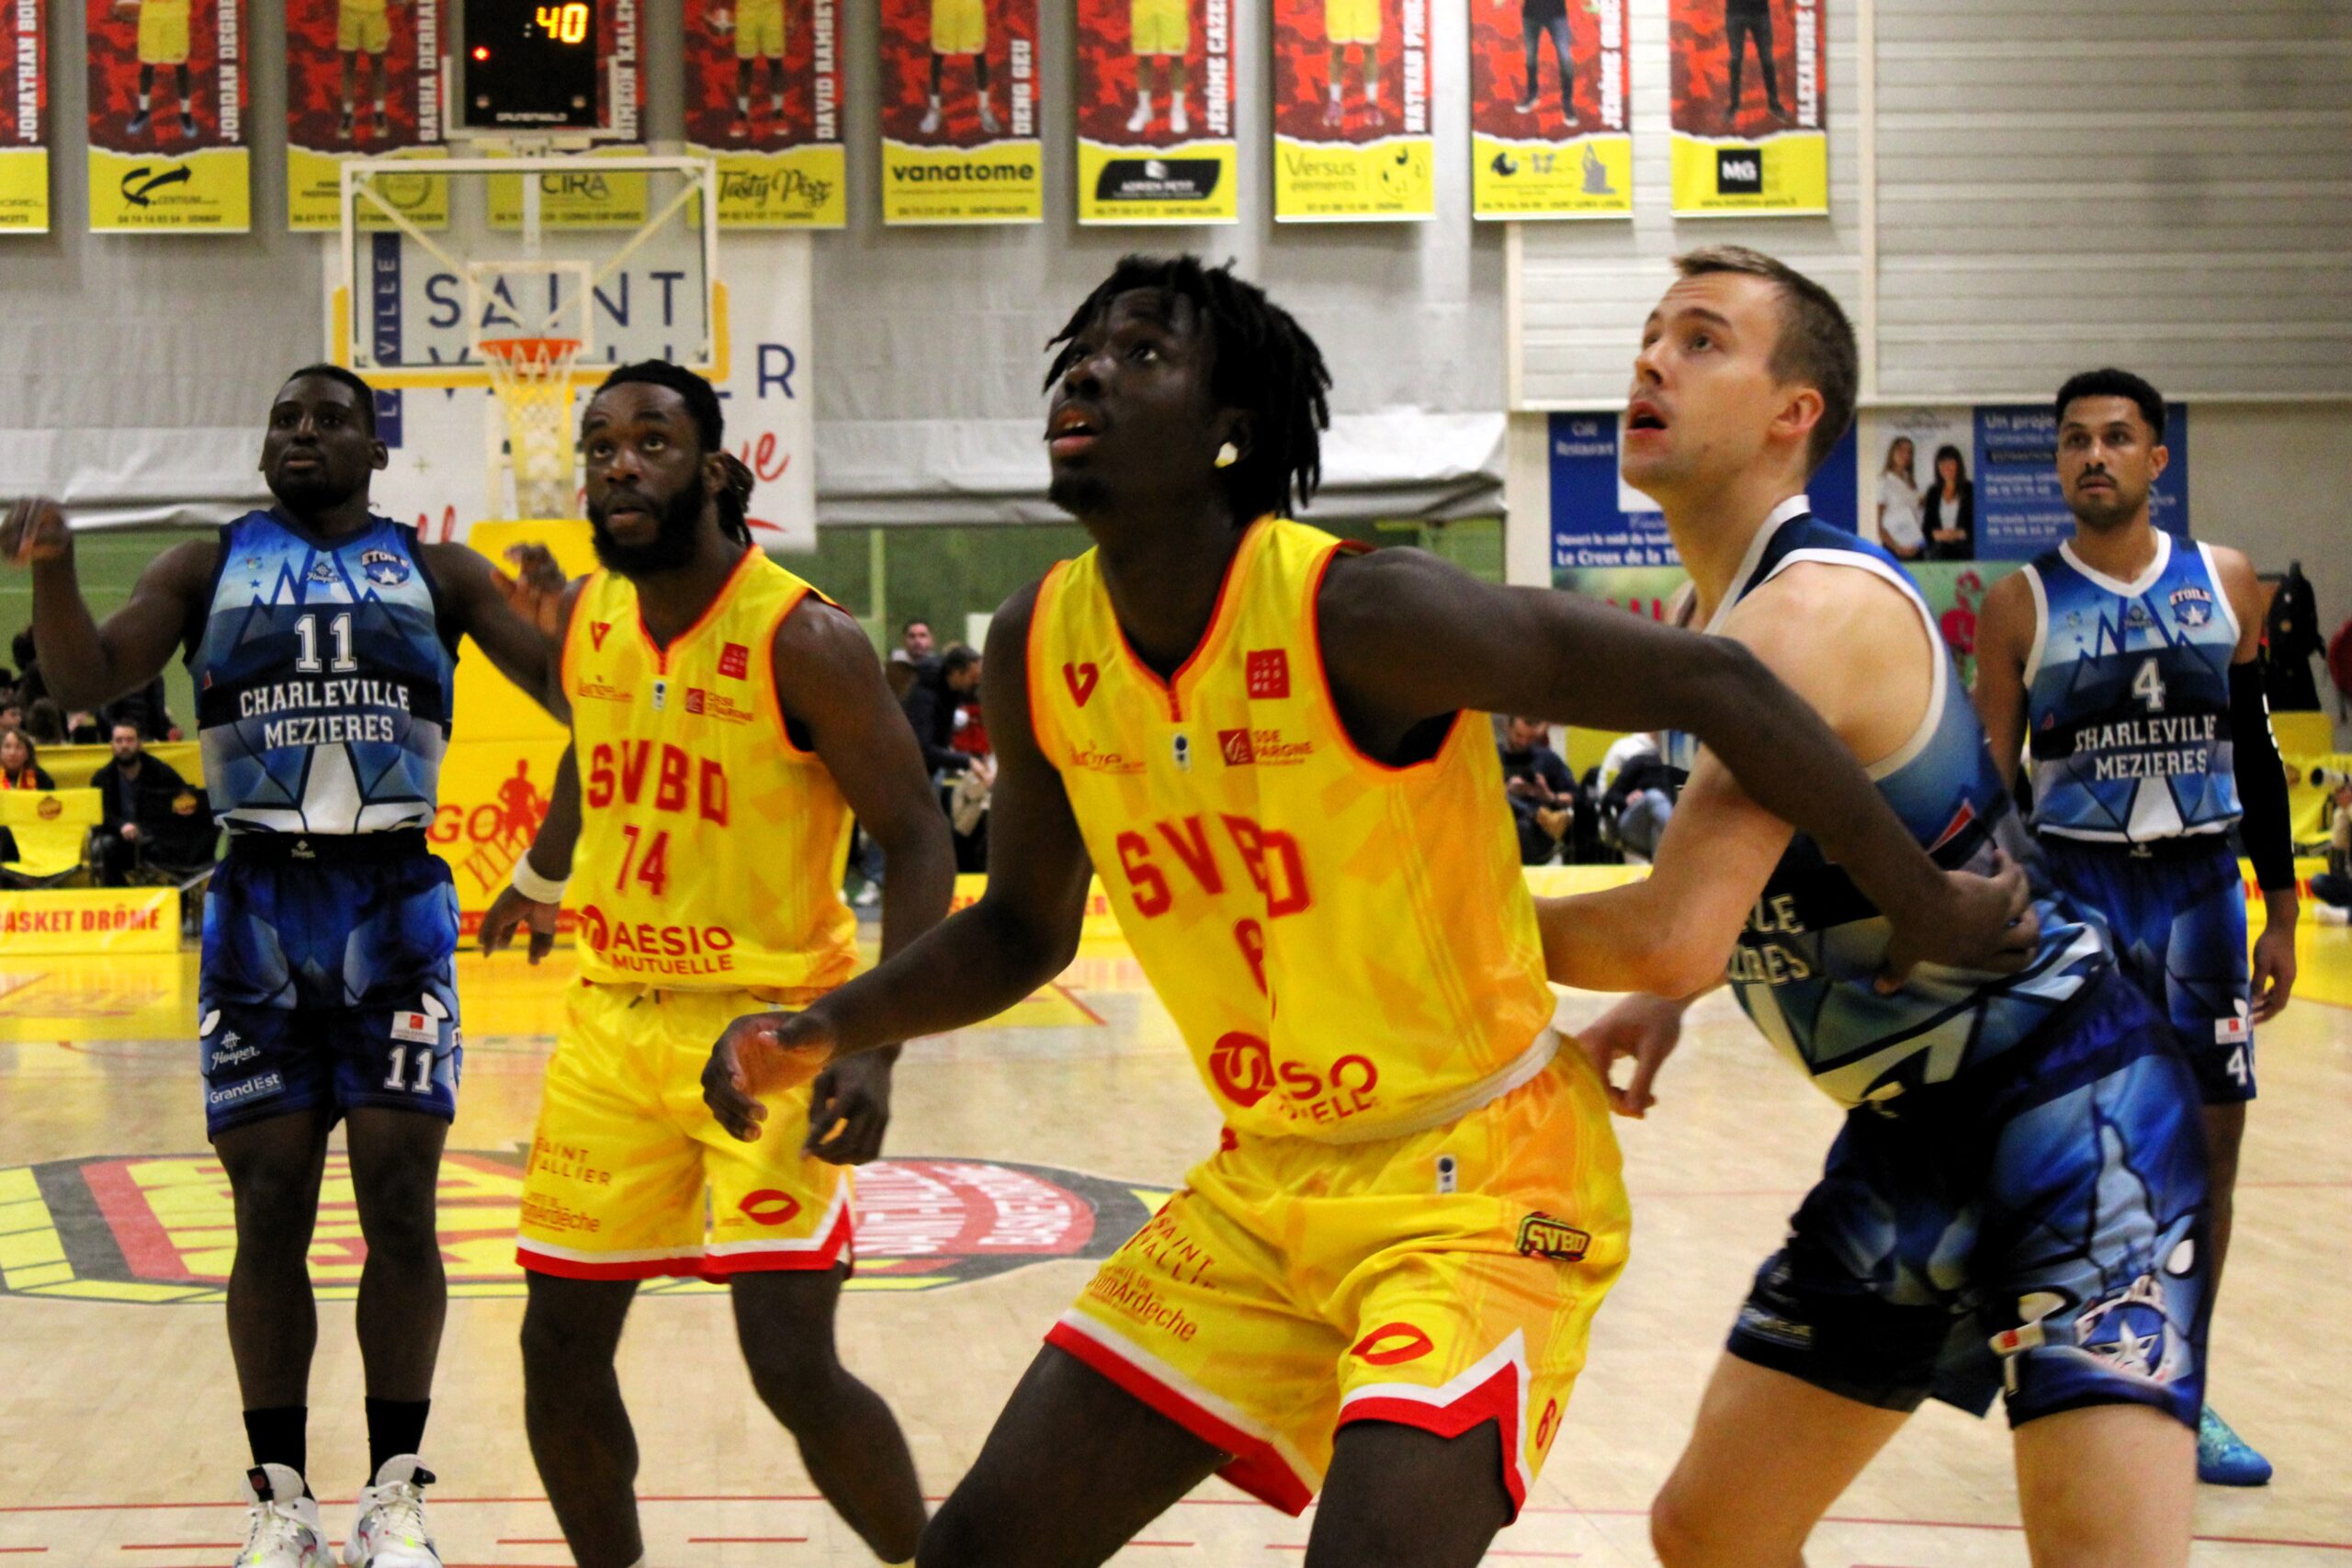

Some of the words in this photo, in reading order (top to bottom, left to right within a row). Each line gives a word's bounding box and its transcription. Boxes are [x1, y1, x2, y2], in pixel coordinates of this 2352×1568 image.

[537, 3, 589, 43] 40
[17, 37, 38, 142] JONATHAN
[220, 63, 239, 141] JORDAN
[815, 77, 835, 140] DAVID
[893, 163, 1035, 182] vanatome
[1284, 152, 1357, 175] Versus
[1722, 160, 1758, 181] MG
[425, 272, 684, 329] SAINT
[295, 613, 358, 673] 11
[239, 678, 411, 718] CHARLEVILLE
[2132, 657, 2166, 713] 4
[263, 715, 395, 751] MEZIERES
[587, 739, 729, 829] SVBD
[2095, 749, 2208, 781] MEZIERES
[616, 823, 670, 897] 74
[0, 910, 74, 933] ASKET
[81, 904, 162, 932] DRÔME
[612, 953, 734, 976] MUTUELLE
[384, 1043, 434, 1096] 11
[2225, 1045, 2248, 1087] 4
[1156, 1216, 1215, 1272] SAINT
[1524, 1224, 1589, 1254] SVBD
